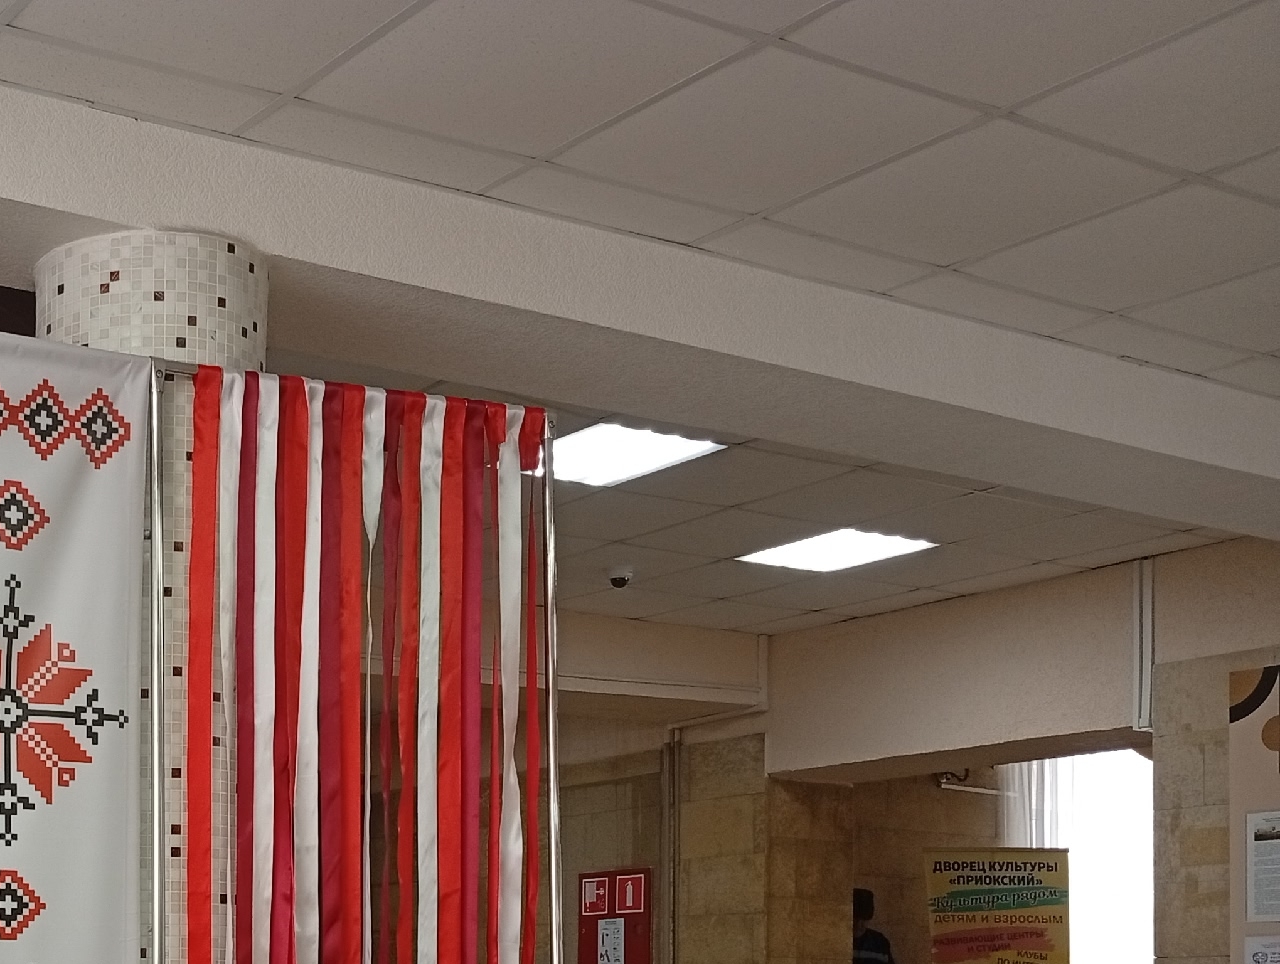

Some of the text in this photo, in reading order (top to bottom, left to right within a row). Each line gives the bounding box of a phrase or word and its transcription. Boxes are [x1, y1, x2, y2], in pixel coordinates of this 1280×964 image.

[933, 861, 1058, 873] ДВОРЕЦ КУЛЬТУРЫ
[949, 873, 1042, 886] «ПРИОКСКИЙ»
[933, 889, 1058, 911] Культура рядом
[934, 914, 1063, 925] детям и взрослым
[933, 931, 1043, 945] РАЗВИВАЮЩИЕ ЦЕНТРЫ
[976, 943, 1011, 952] СТУДИИ
[1017, 950, 1048, 960] КЛУБЫ
